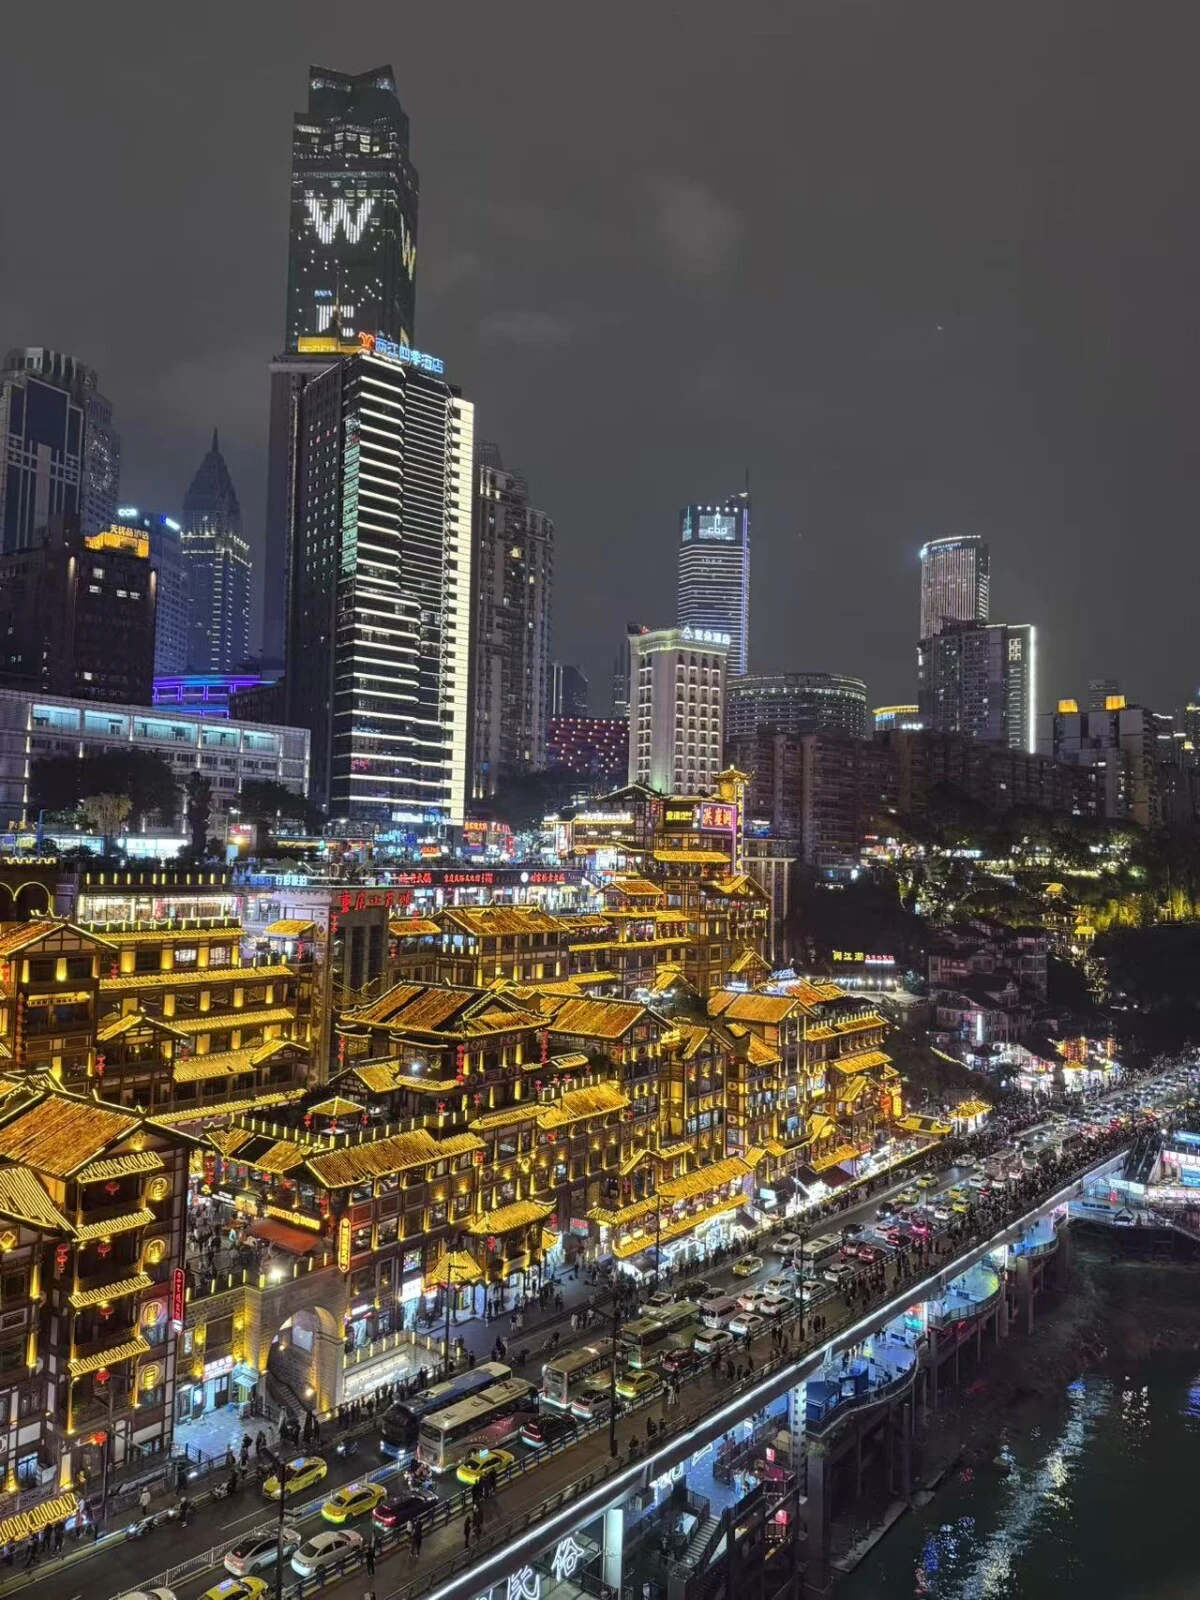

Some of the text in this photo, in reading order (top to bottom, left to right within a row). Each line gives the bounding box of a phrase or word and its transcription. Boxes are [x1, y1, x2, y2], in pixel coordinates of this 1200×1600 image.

[304, 198, 375, 244] W
[703, 806, 732, 827] 洪崖洞
